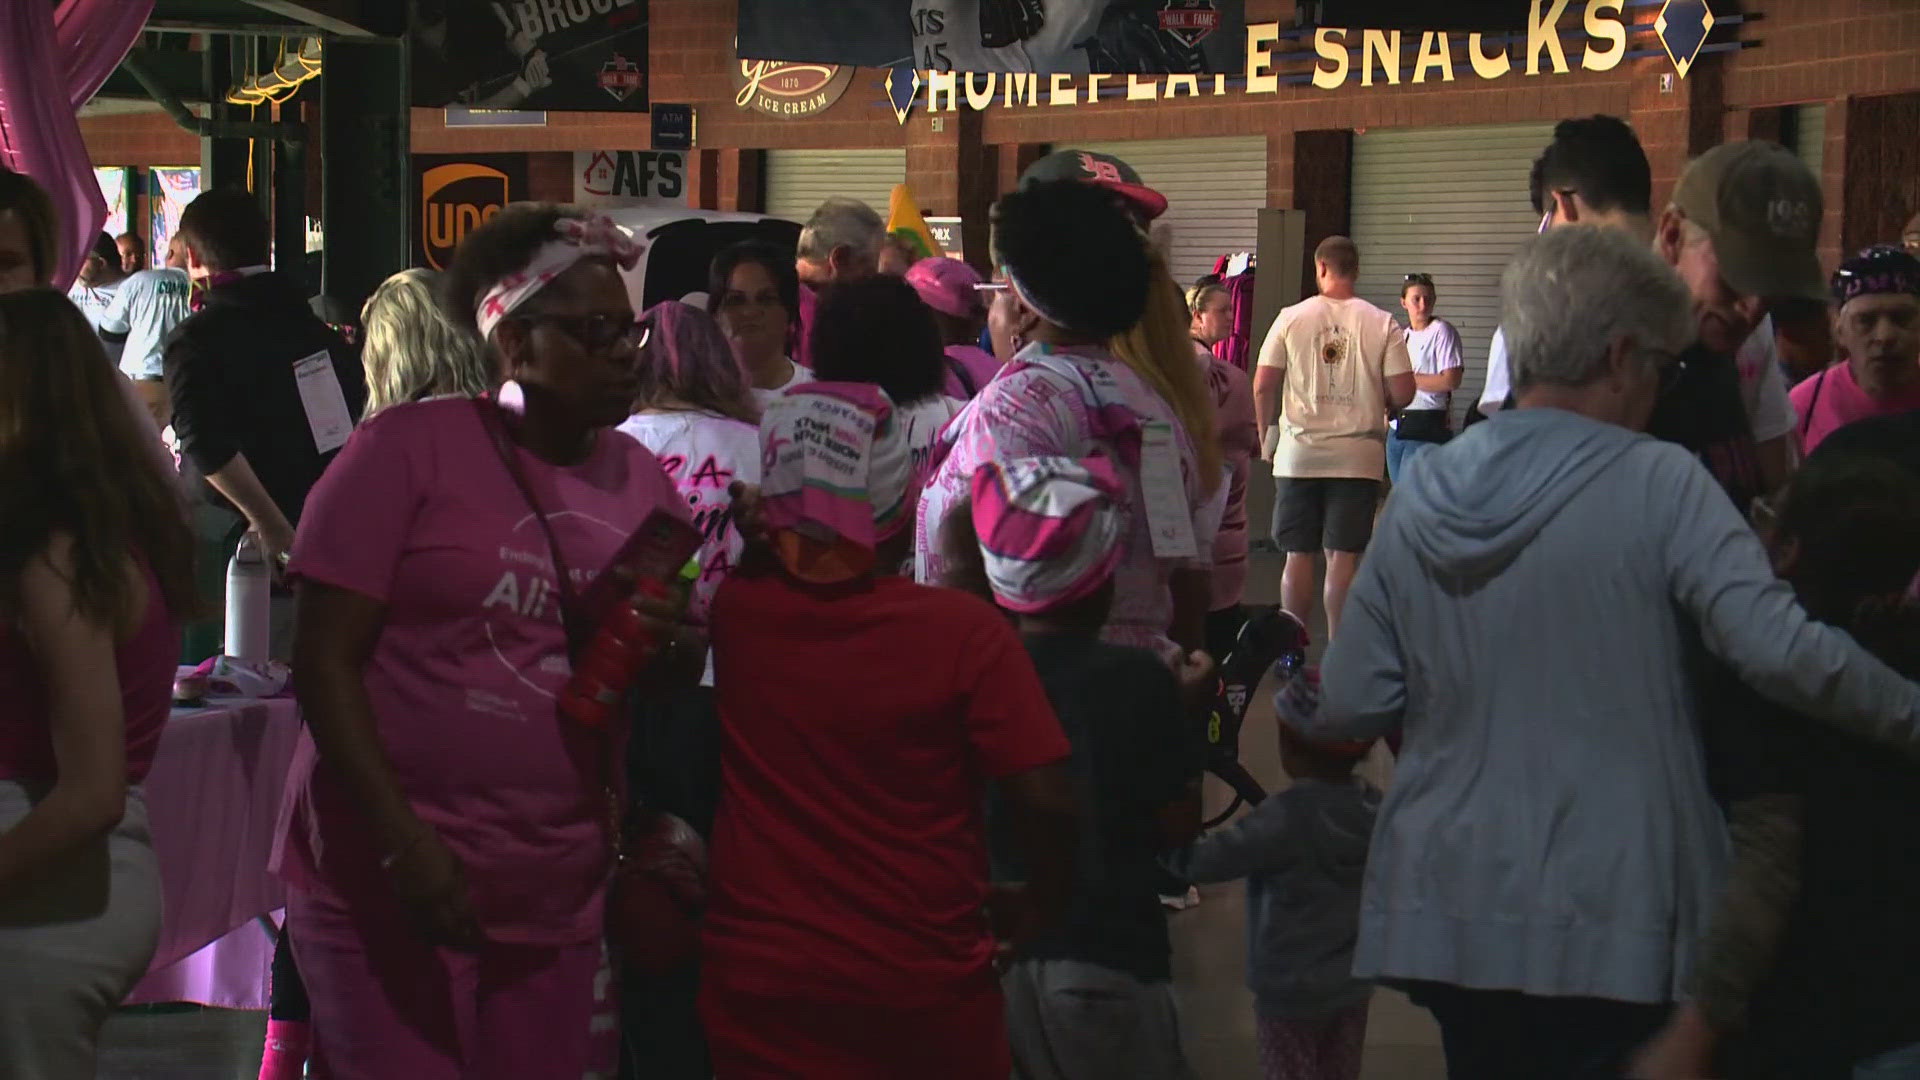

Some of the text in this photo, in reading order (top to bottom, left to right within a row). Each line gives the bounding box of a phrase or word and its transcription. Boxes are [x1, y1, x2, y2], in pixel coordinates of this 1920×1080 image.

[1193, 13, 1214, 26] FAME
[1311, 0, 1627, 89] SNACKS
[781, 78, 799, 89] 1870
[759, 92, 827, 114] ICE CREAM
[661, 113, 684, 124] ATM
[612, 151, 682, 198] AFS
